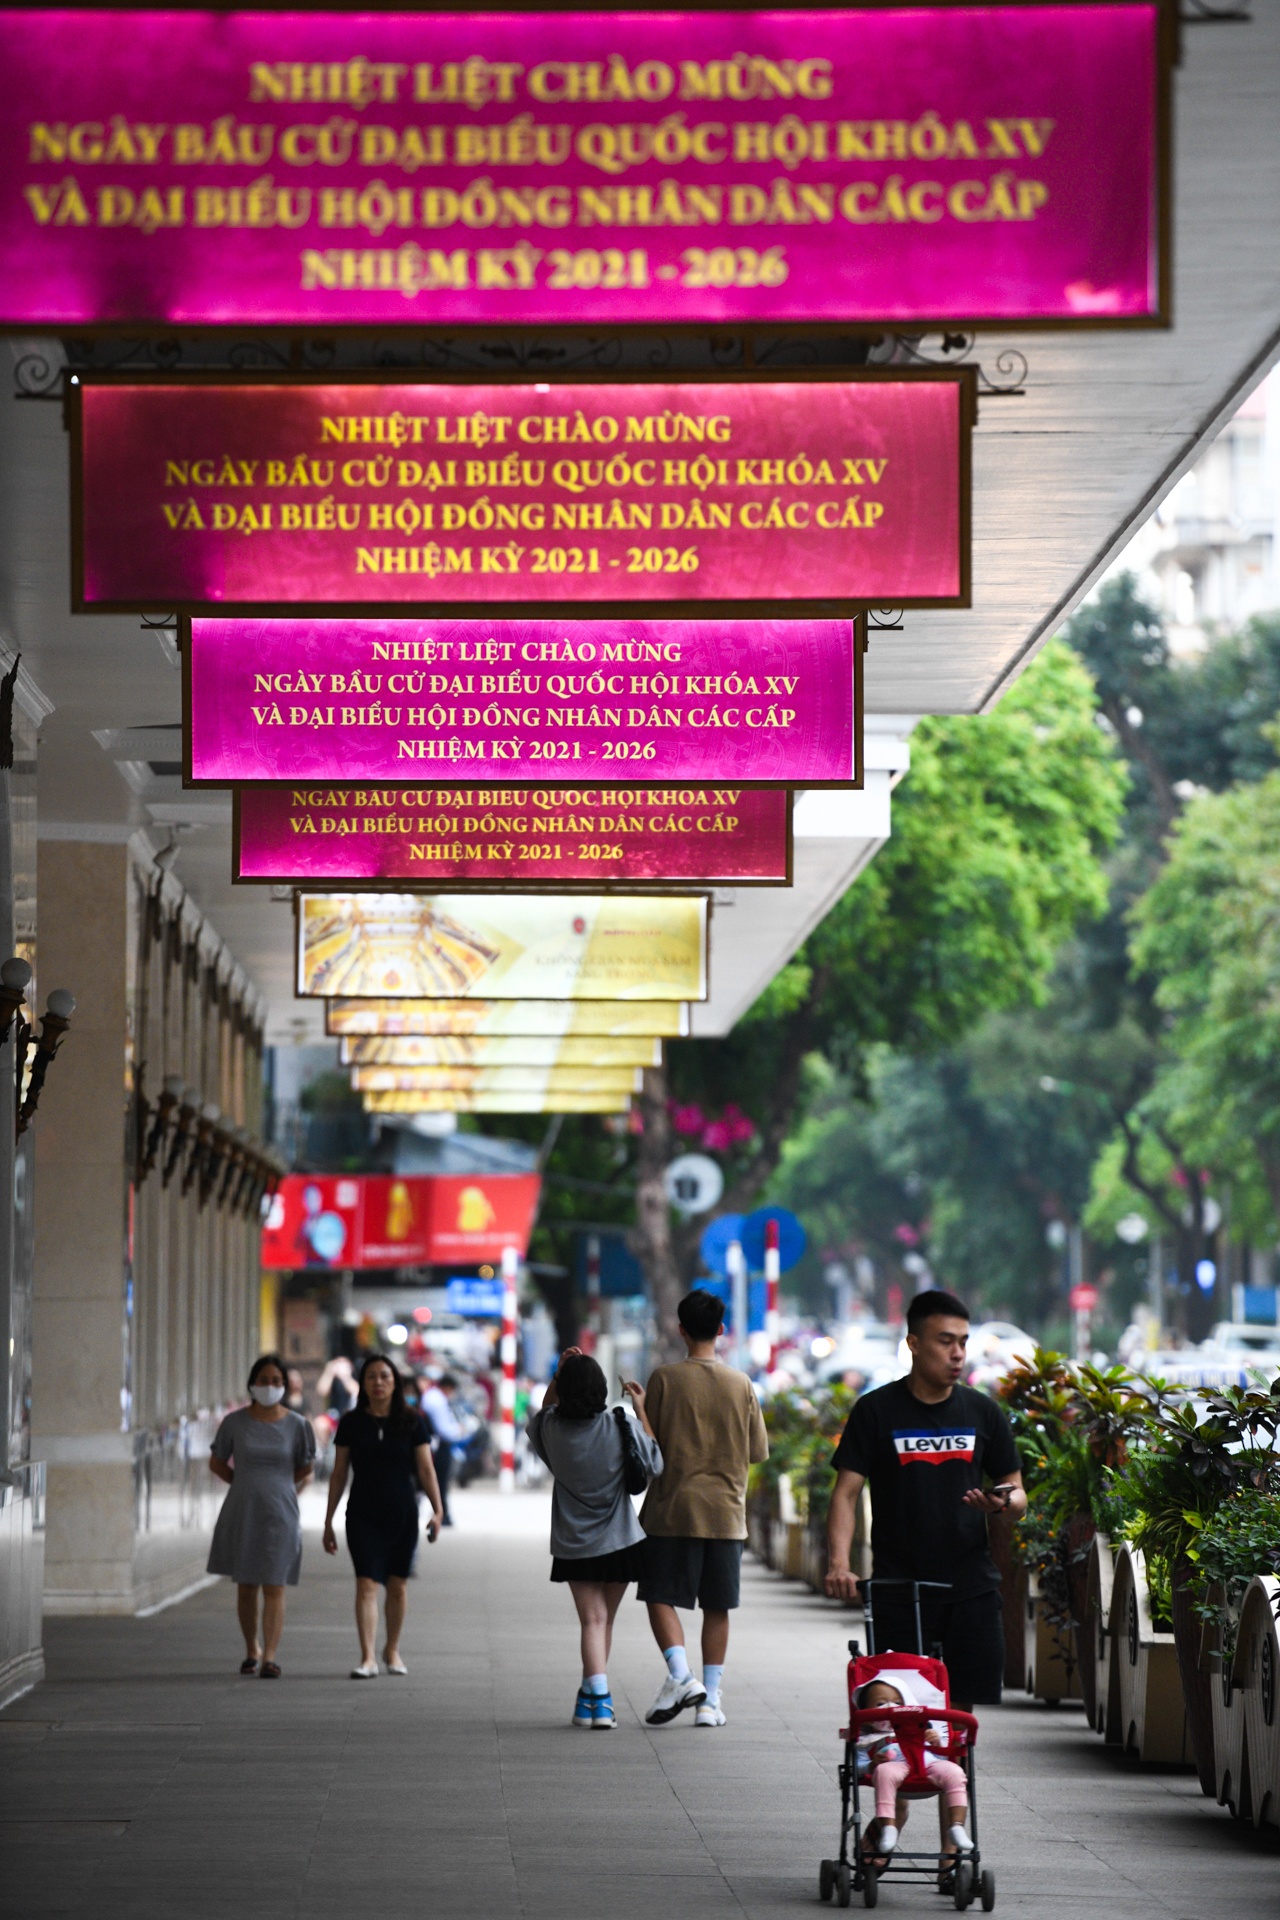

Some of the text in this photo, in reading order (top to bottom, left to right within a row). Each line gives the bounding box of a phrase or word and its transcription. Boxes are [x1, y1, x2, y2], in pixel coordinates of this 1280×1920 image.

[250, 55, 408, 109] NHIỆT
[413, 55, 524, 110] LIỆT
[527, 54, 675, 102] CHÀO
[30, 115, 166, 164] NGÀY
[575, 113, 727, 174] QUỐC
[732, 114, 830, 170] HỘI
[836, 111, 981, 162] KHÓA
[985, 118, 1054, 159] XV
[25, 177, 91, 226] VÀ
[318, 180, 415, 237] HỘI
[577, 179, 723, 227] NHÂN
[729, 177, 835, 225] DÂN
[839, 175, 943, 225] CÁC
[301, 242, 471, 299] NHIỆM
[547, 248, 650, 290] 2021
[680, 246, 789, 289] 2026
[321, 409, 731, 449] NHIỆT LIỆT CHÀO MỪNG
[165, 454, 259, 487] NGÀY
[341, 453, 394, 488] CỬ
[397, 460, 458, 493] ĐẠI
[464, 451, 546, 487] BIỂU
[551, 451, 656, 494] QUỐC
[662, 453, 730, 492] HỘI
[735, 452, 837, 486] KHÓA
[841, 458, 888, 485] XV
[161, 494, 884, 536] VÀ ĐẠI BIỂU HỘI ĐỒNG NHÂN DÂN CÁC CẤP
[355, 541, 474, 580] NHIỆM
[479, 540, 526, 574] KỲ
[530, 547, 601, 574] 2021
[626, 546, 700, 574] 2026
[371, 636, 682, 666] NHIỆT LIỆT CHÀO MỪNG
[253, 668, 801, 700] NGÀY BẦU CỬ ĐẠI BIỂU QUỐC HỘI KHÓA XV
[250, 700, 796, 731] VÀ ĐẠI BIỂU HỘI ĐỒNG NHÂN DÂN CÁC CẤP
[396, 735, 487, 763] NHIỆM
[490, 735, 526, 760] KỲ
[528, 740, 583, 760] 2021
[601, 740, 657, 760] 2026
[435, 790, 474, 810] ĐẠI
[711, 789, 742, 806] XV
[289, 811, 739, 837] VÀ ĐẠI BIỂU HỘI ĐỒNG NHÂN DÂN CÁC CẤP
[408, 840, 483, 863] NHIỆM
[486, 839, 516, 860] KỲ
[518, 843, 563, 860] 2021
[577, 843, 624, 861] 2026
